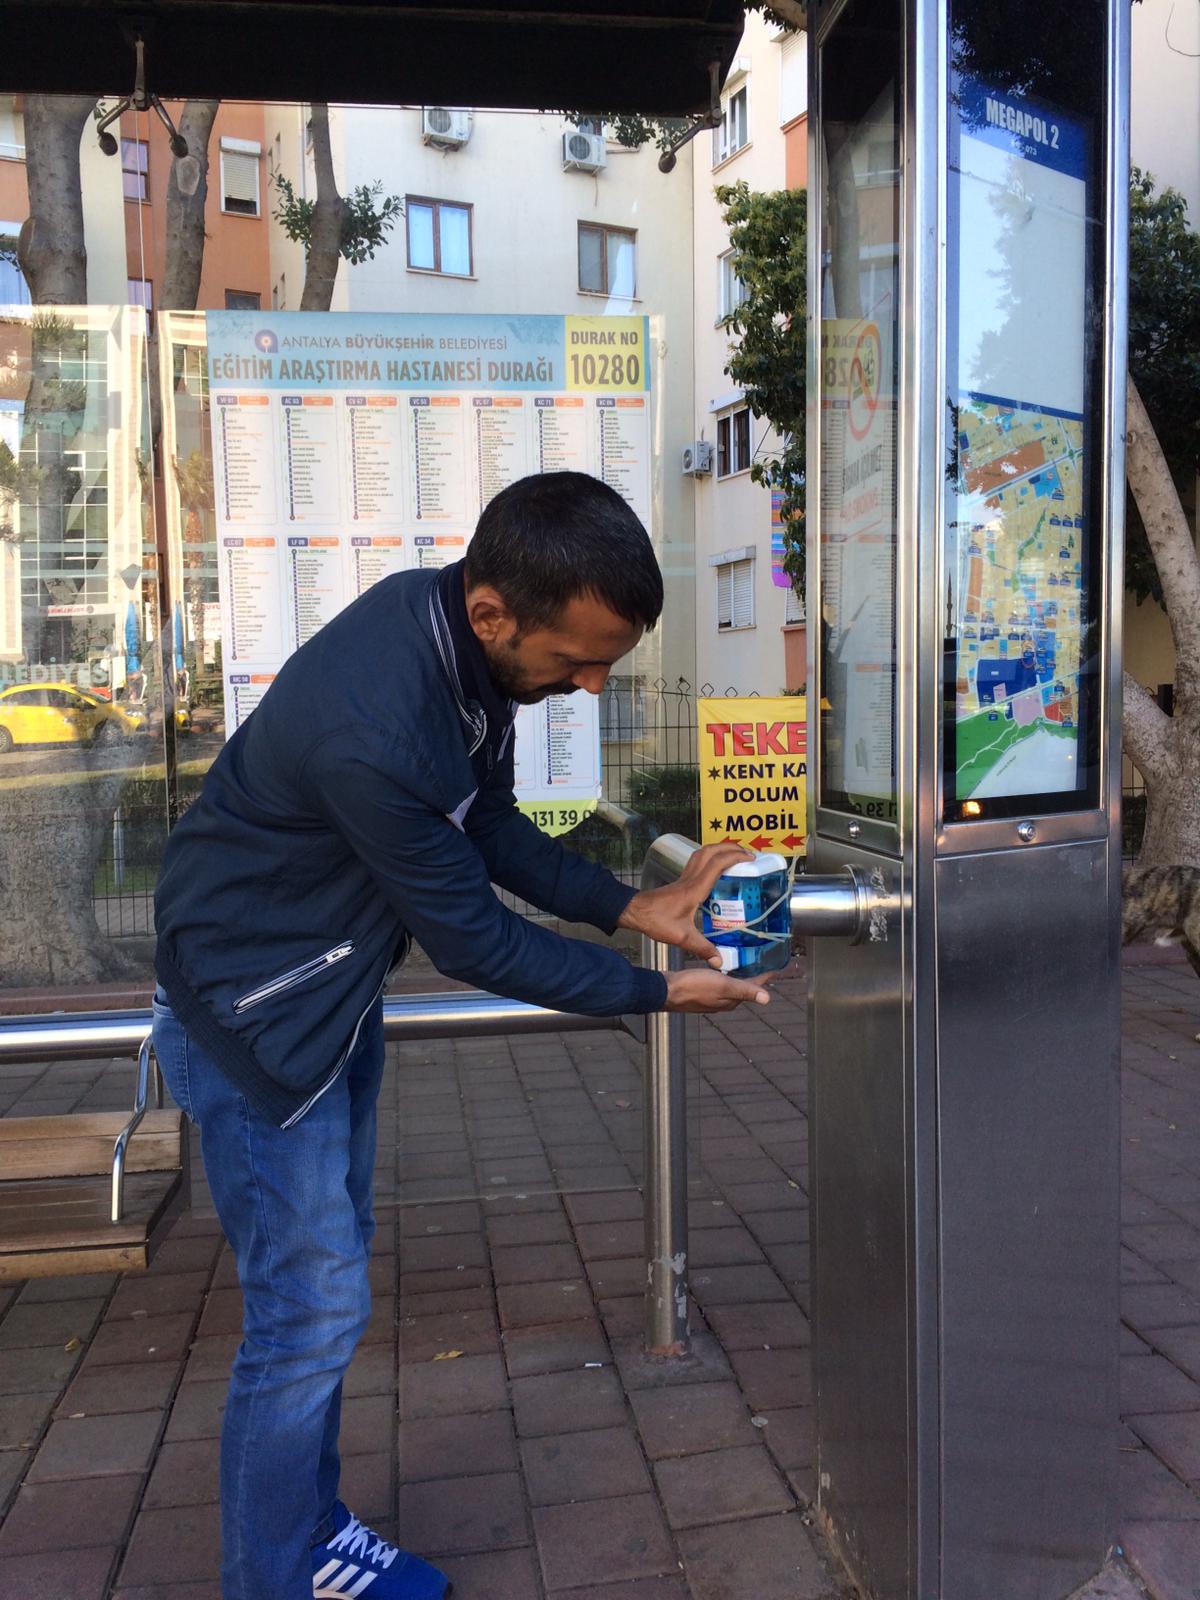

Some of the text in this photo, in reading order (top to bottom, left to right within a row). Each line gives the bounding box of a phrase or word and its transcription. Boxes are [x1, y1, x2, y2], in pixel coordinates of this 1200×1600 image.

[985, 97, 1060, 149] MEGAPOL 2
[281, 333, 508, 351] ANTALYA BÜYÜKŞEHİR BELEDİYESİ
[571, 331, 638, 345] DURAK NO
[212, 352, 553, 383] EĞİTİM ARAŞTIRMA HASTANESİ DURAĞI
[570, 354, 640, 385] 10280
[706, 721, 807, 757] TEKE
[723, 763, 807, 780] KENT KA
[724, 786, 799, 803] DOLUM
[531, 811, 554, 826] 131
[559, 810, 578, 826] 39
[725, 808, 799, 832] MOBİL
